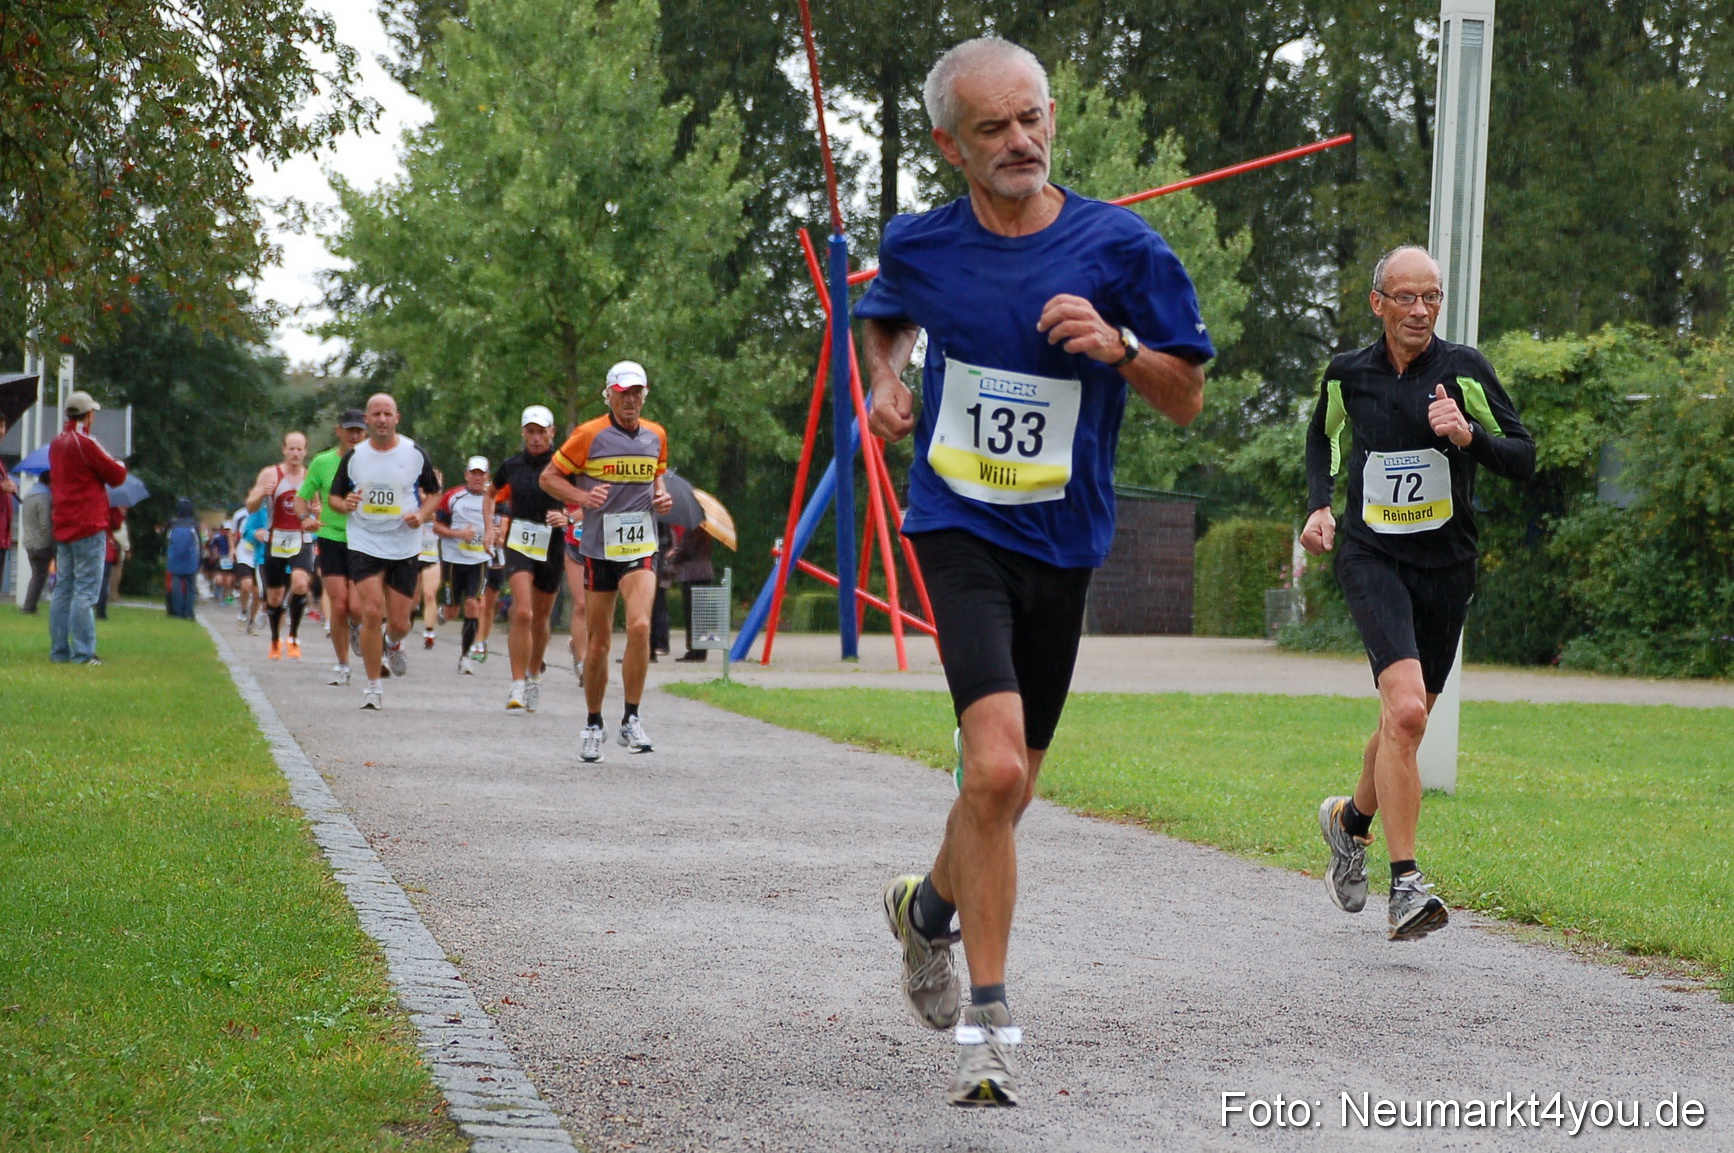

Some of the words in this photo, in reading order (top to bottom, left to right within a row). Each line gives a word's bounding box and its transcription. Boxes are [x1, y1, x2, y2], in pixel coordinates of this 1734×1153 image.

[980, 377, 1038, 397] BOCK
[966, 402, 1046, 458] 133
[1383, 455, 1420, 467] BOCK
[979, 462, 1017, 486] Willi
[1385, 472, 1424, 504] 72
[368, 490, 394, 506] 209
[1382, 505, 1434, 522] Reinhard
[522, 531, 537, 546] 91
[616, 525, 645, 543] 144
